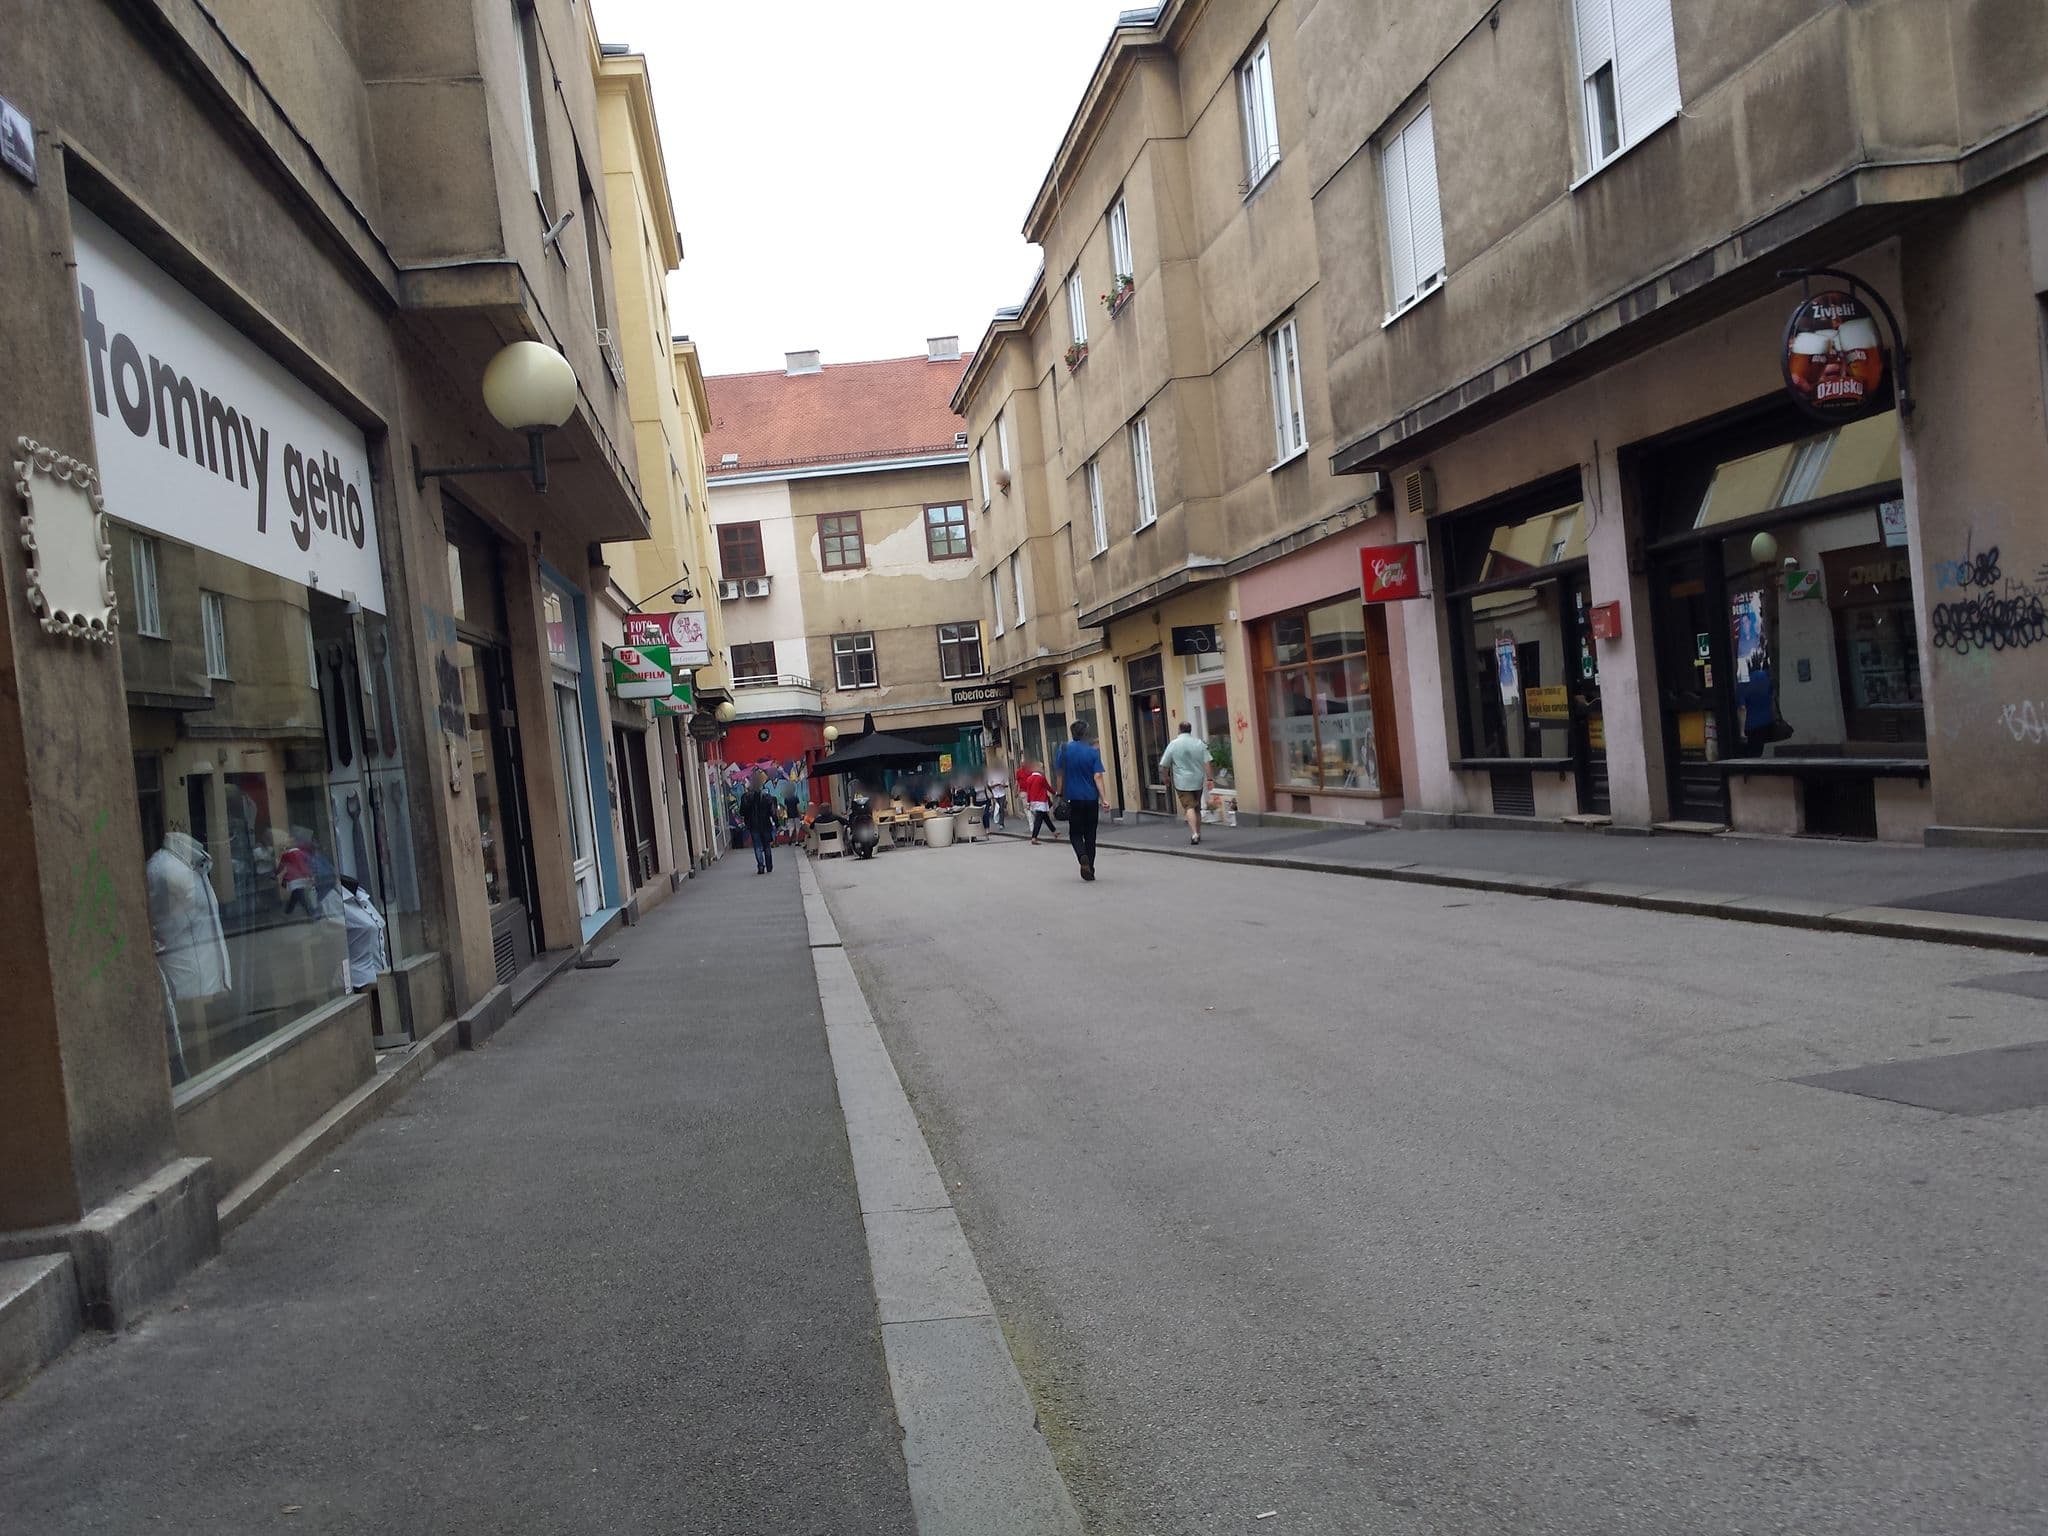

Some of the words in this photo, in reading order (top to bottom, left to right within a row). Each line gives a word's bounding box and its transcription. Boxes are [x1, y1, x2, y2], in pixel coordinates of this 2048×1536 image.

[1812, 302, 1855, 319] Živjeli!
[1817, 379, 1864, 399] Ožujsko
[81, 282, 269, 534] tommy
[284, 443, 365, 551] getto
[622, 671, 665, 680] FUJIFILM
[954, 689, 984, 702] roberto
[985, 688, 1008, 699] cava
